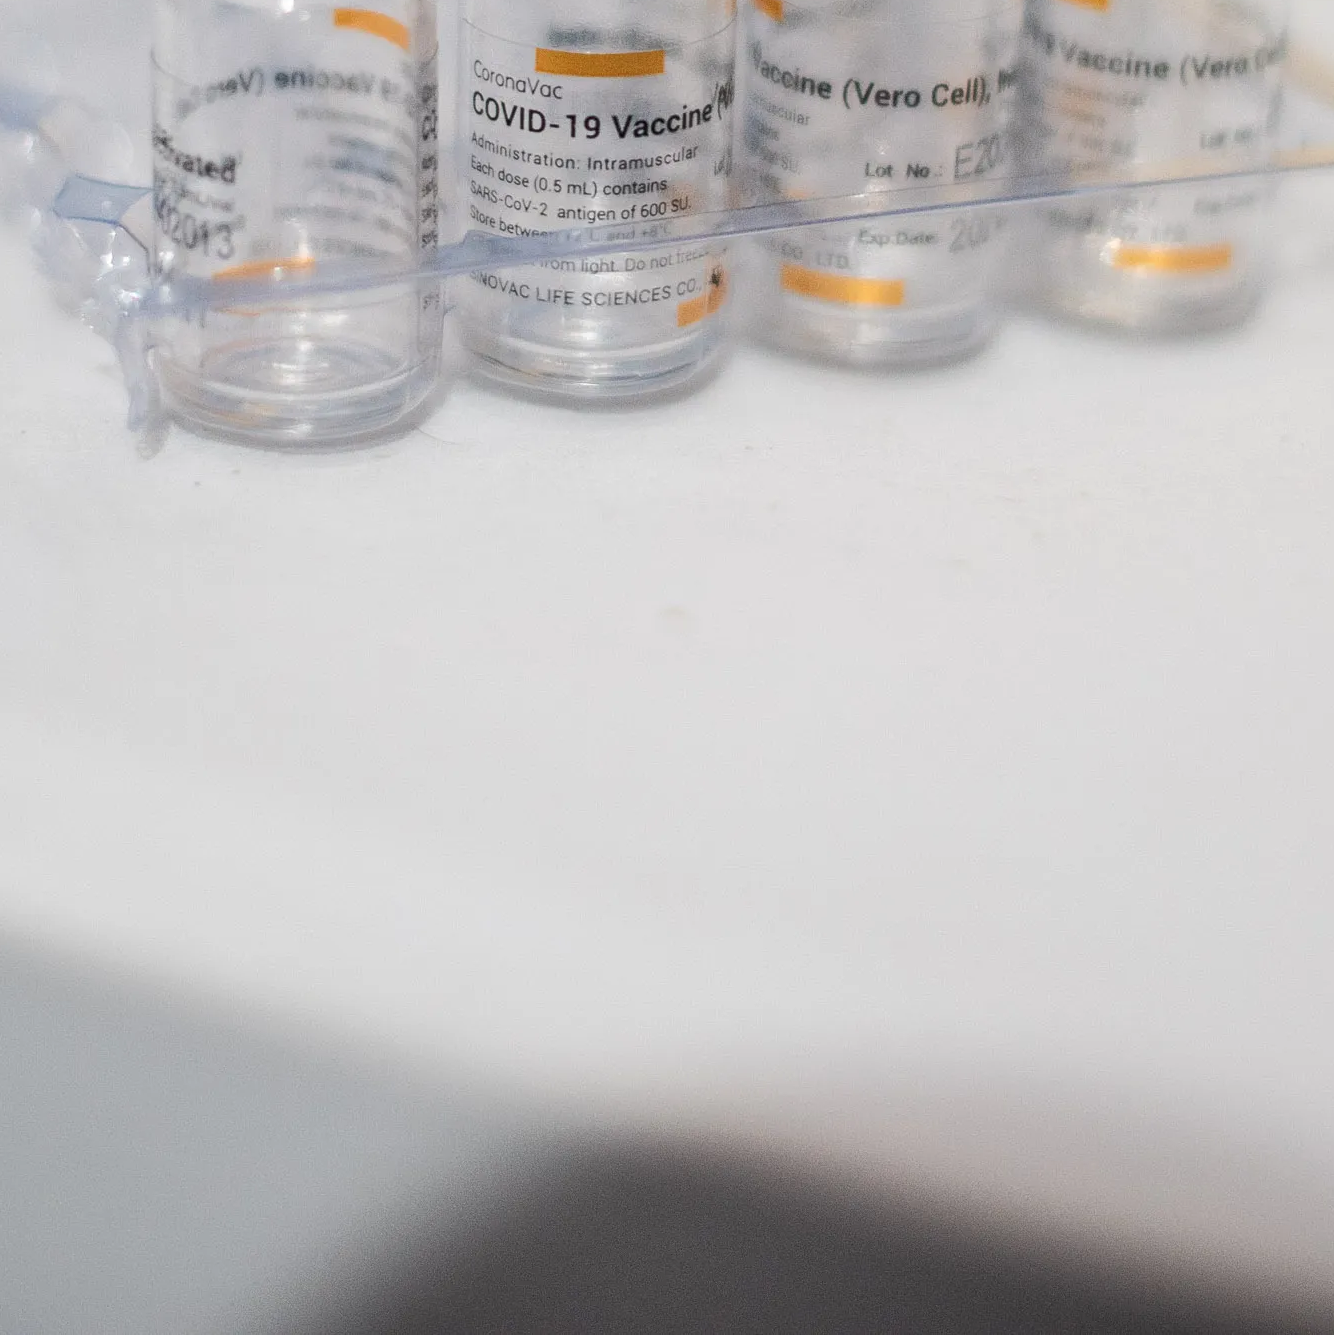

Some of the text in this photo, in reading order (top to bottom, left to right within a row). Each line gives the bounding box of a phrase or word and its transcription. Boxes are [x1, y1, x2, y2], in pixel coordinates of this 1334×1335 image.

[473, 60, 564, 99] CoronaVac
[843, 78, 920, 109] (Vero
[472, 91, 601, 139] COVID-19
[612, 104, 713, 139] Vaccine
[471, 130, 580, 170] Administration:
[587, 145, 698, 171] Intramuscular
[471, 155, 494, 178] Each
[498, 169, 529, 188] dose
[533, 173, 562, 193] (0.5
[567, 180, 598, 198] mL)
[864, 162, 893, 178] Lot
[469, 204, 496, 228] Store
[470, 180, 548, 217] SARS-CoV-2
[557, 204, 616, 224] antigen
[620, 201, 636, 219] of
[640, 201, 667, 219] 600
[624, 256, 646, 272] Do
[650, 253, 675, 269] not
[535, 286, 574, 305] LIFE
[581, 285, 671, 306] SCIENCES
